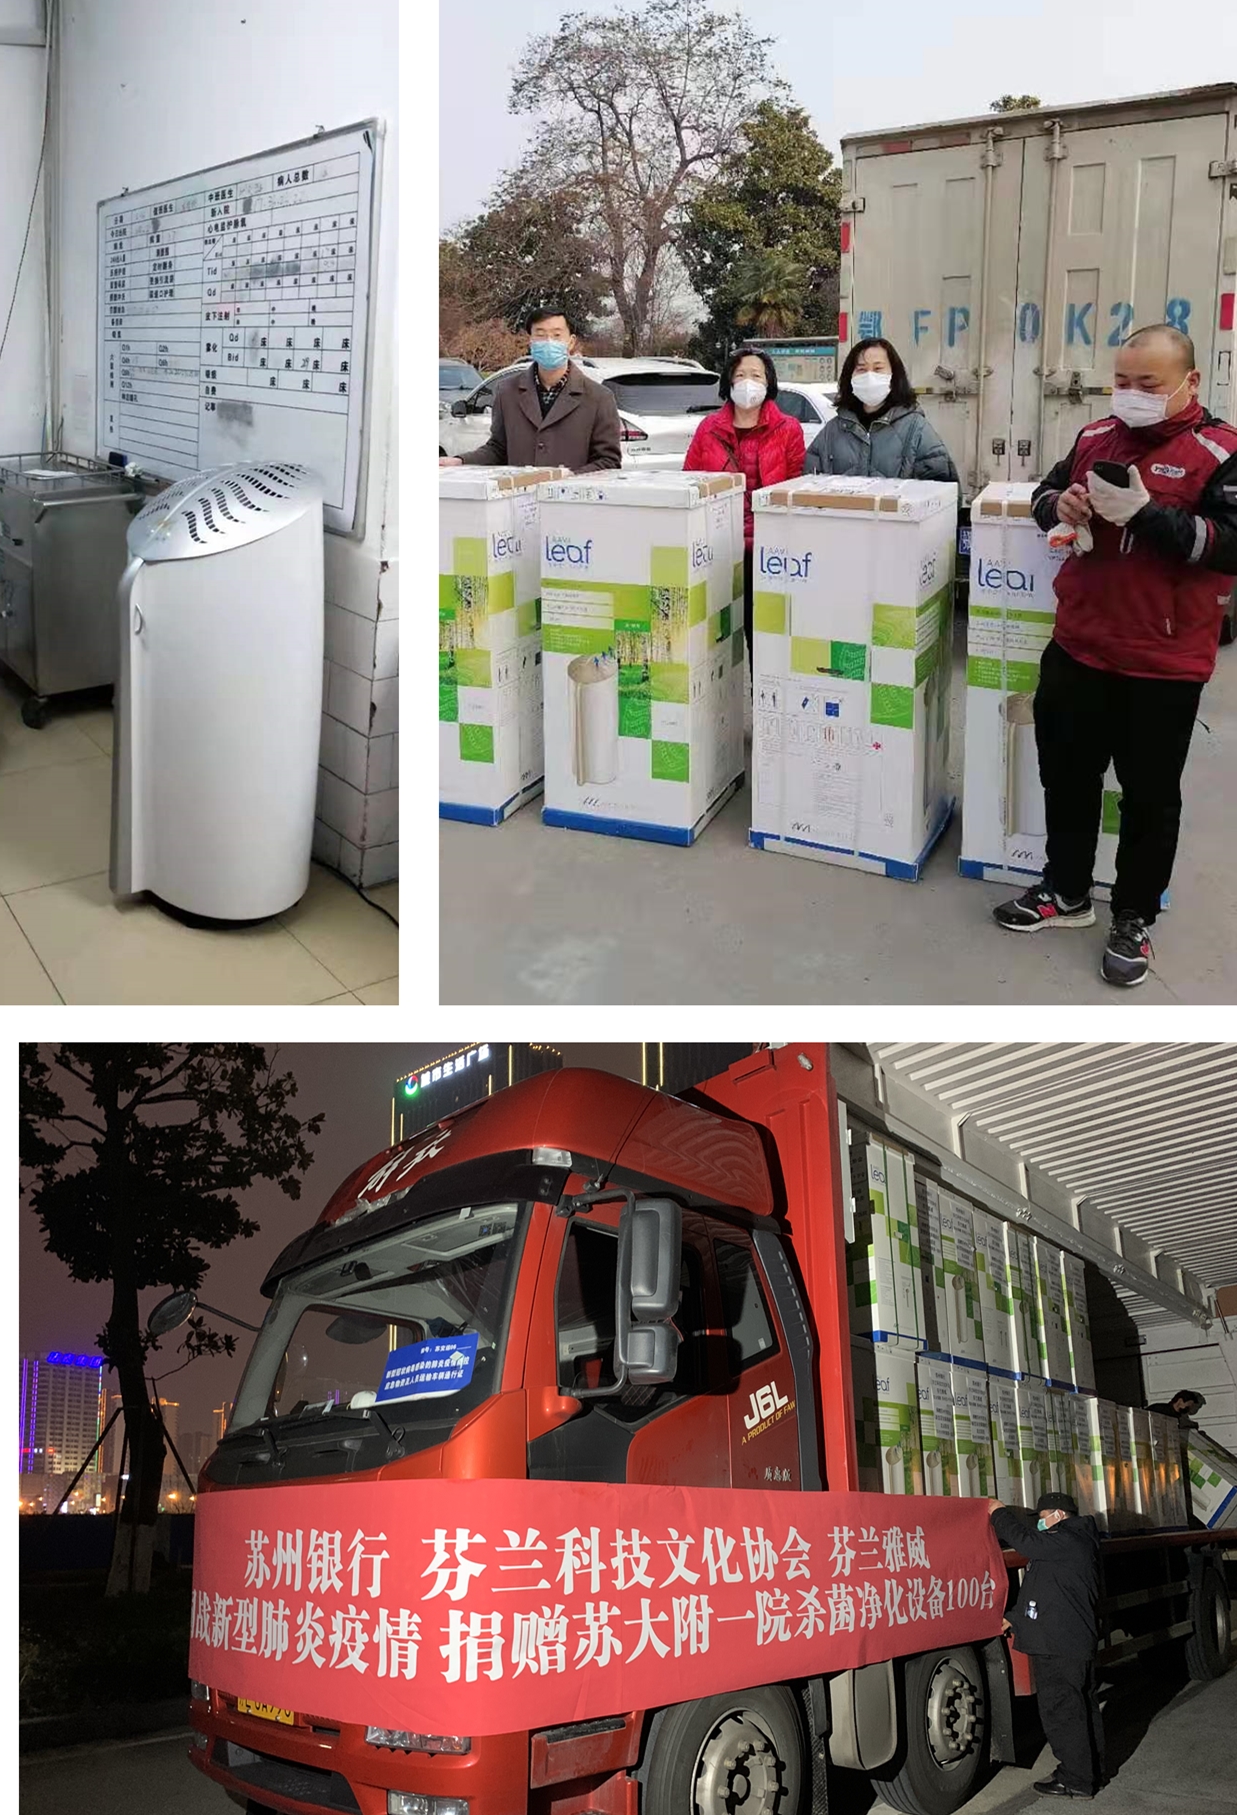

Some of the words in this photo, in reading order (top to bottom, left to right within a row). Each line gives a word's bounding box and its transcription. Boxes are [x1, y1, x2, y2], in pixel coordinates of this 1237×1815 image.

[545, 535, 593, 564] leaf
[760, 546, 812, 578] leaf
[743, 1380, 789, 1430] J6L
[747, 1417, 775, 1441] PRODUCT
[243, 1528, 391, 1598] 苏州银行
[420, 1526, 812, 1602] 芬兰科技文化协会
[827, 1525, 932, 1578] 芬兰雅威
[439, 1571, 996, 1683] 捐赠苏大附一院杀菌净化设备100台
